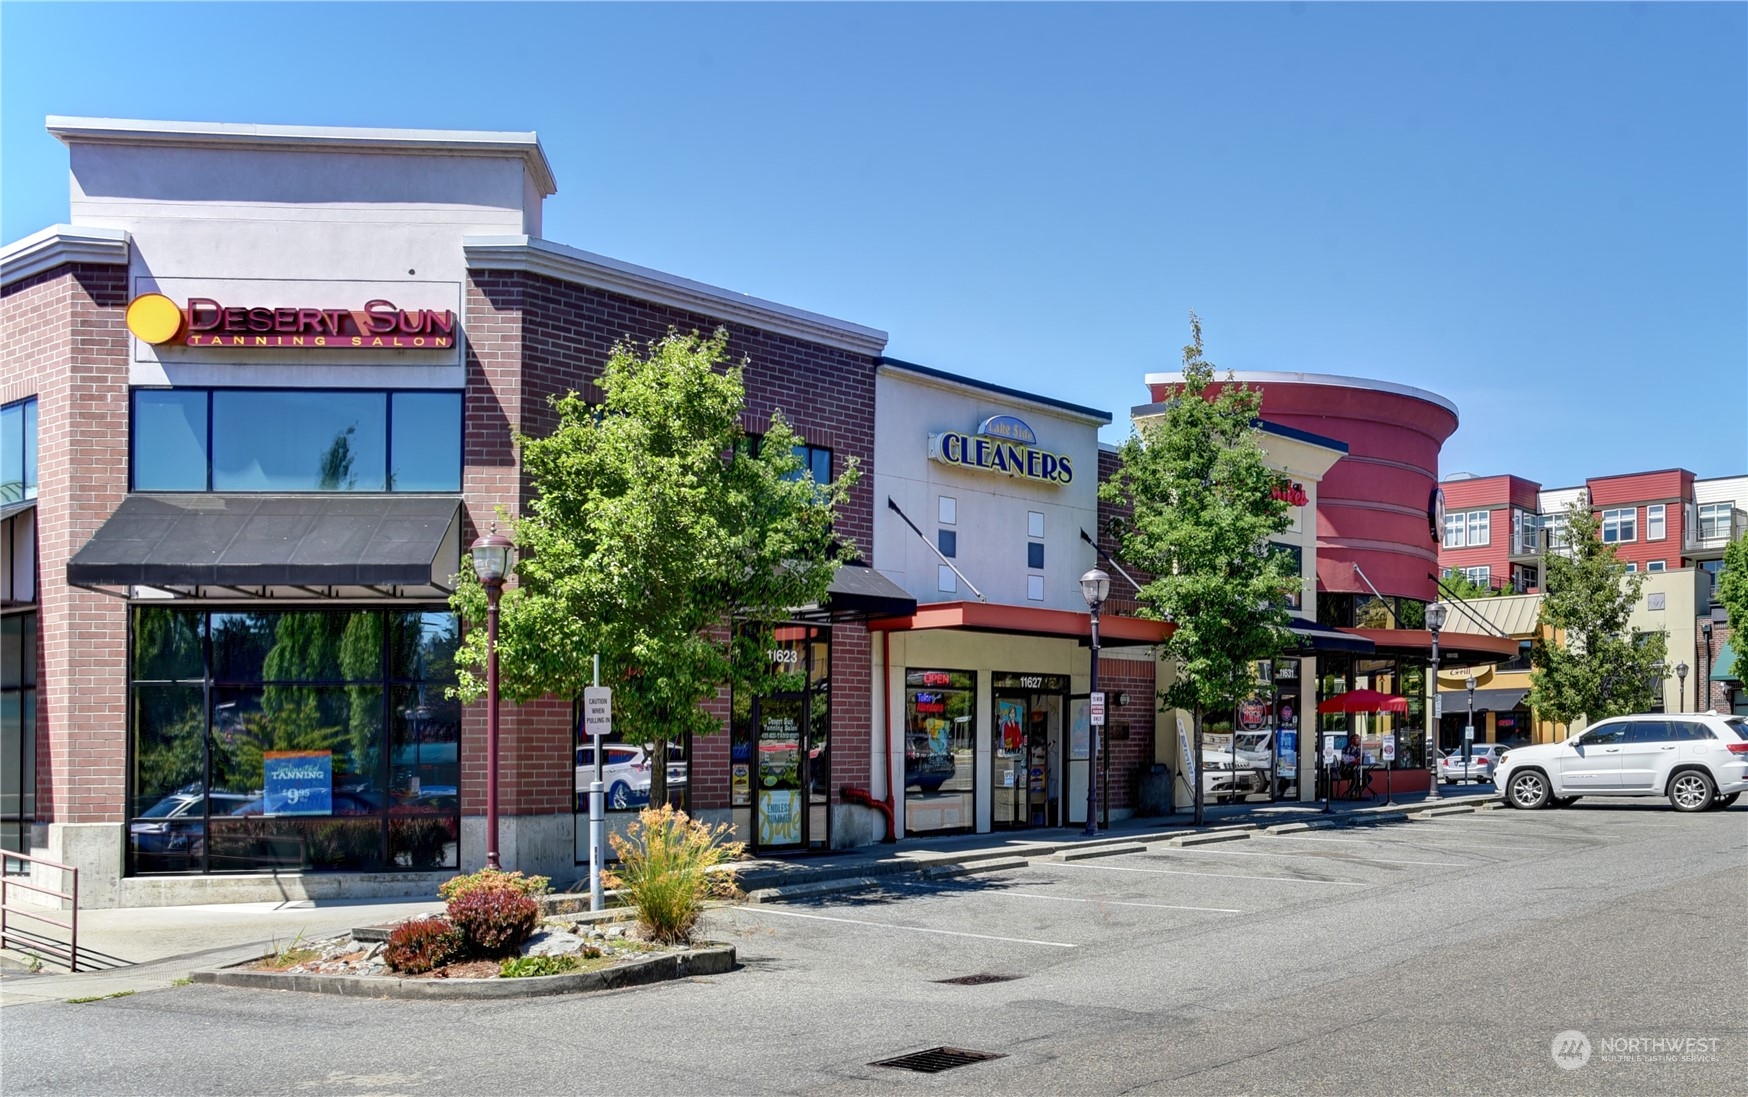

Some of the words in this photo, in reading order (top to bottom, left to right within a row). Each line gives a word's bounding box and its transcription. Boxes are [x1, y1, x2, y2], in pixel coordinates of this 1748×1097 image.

[187, 297, 349, 336] DESERT
[362, 298, 452, 334] SUN
[190, 335, 326, 346] TANNING
[351, 335, 448, 347] SALON
[987, 421, 1011, 435] Lake
[1013, 423, 1034, 441] Side
[940, 432, 1074, 485] CLEANERS
[766, 649, 798, 663] 11623
[923, 673, 950, 684] OPEN
[1279, 668, 1294, 678] 11631
[1019, 675, 1042, 688] 11627
[271, 771, 324, 780] TANNING
[767, 803, 791, 814] ENDLESS
